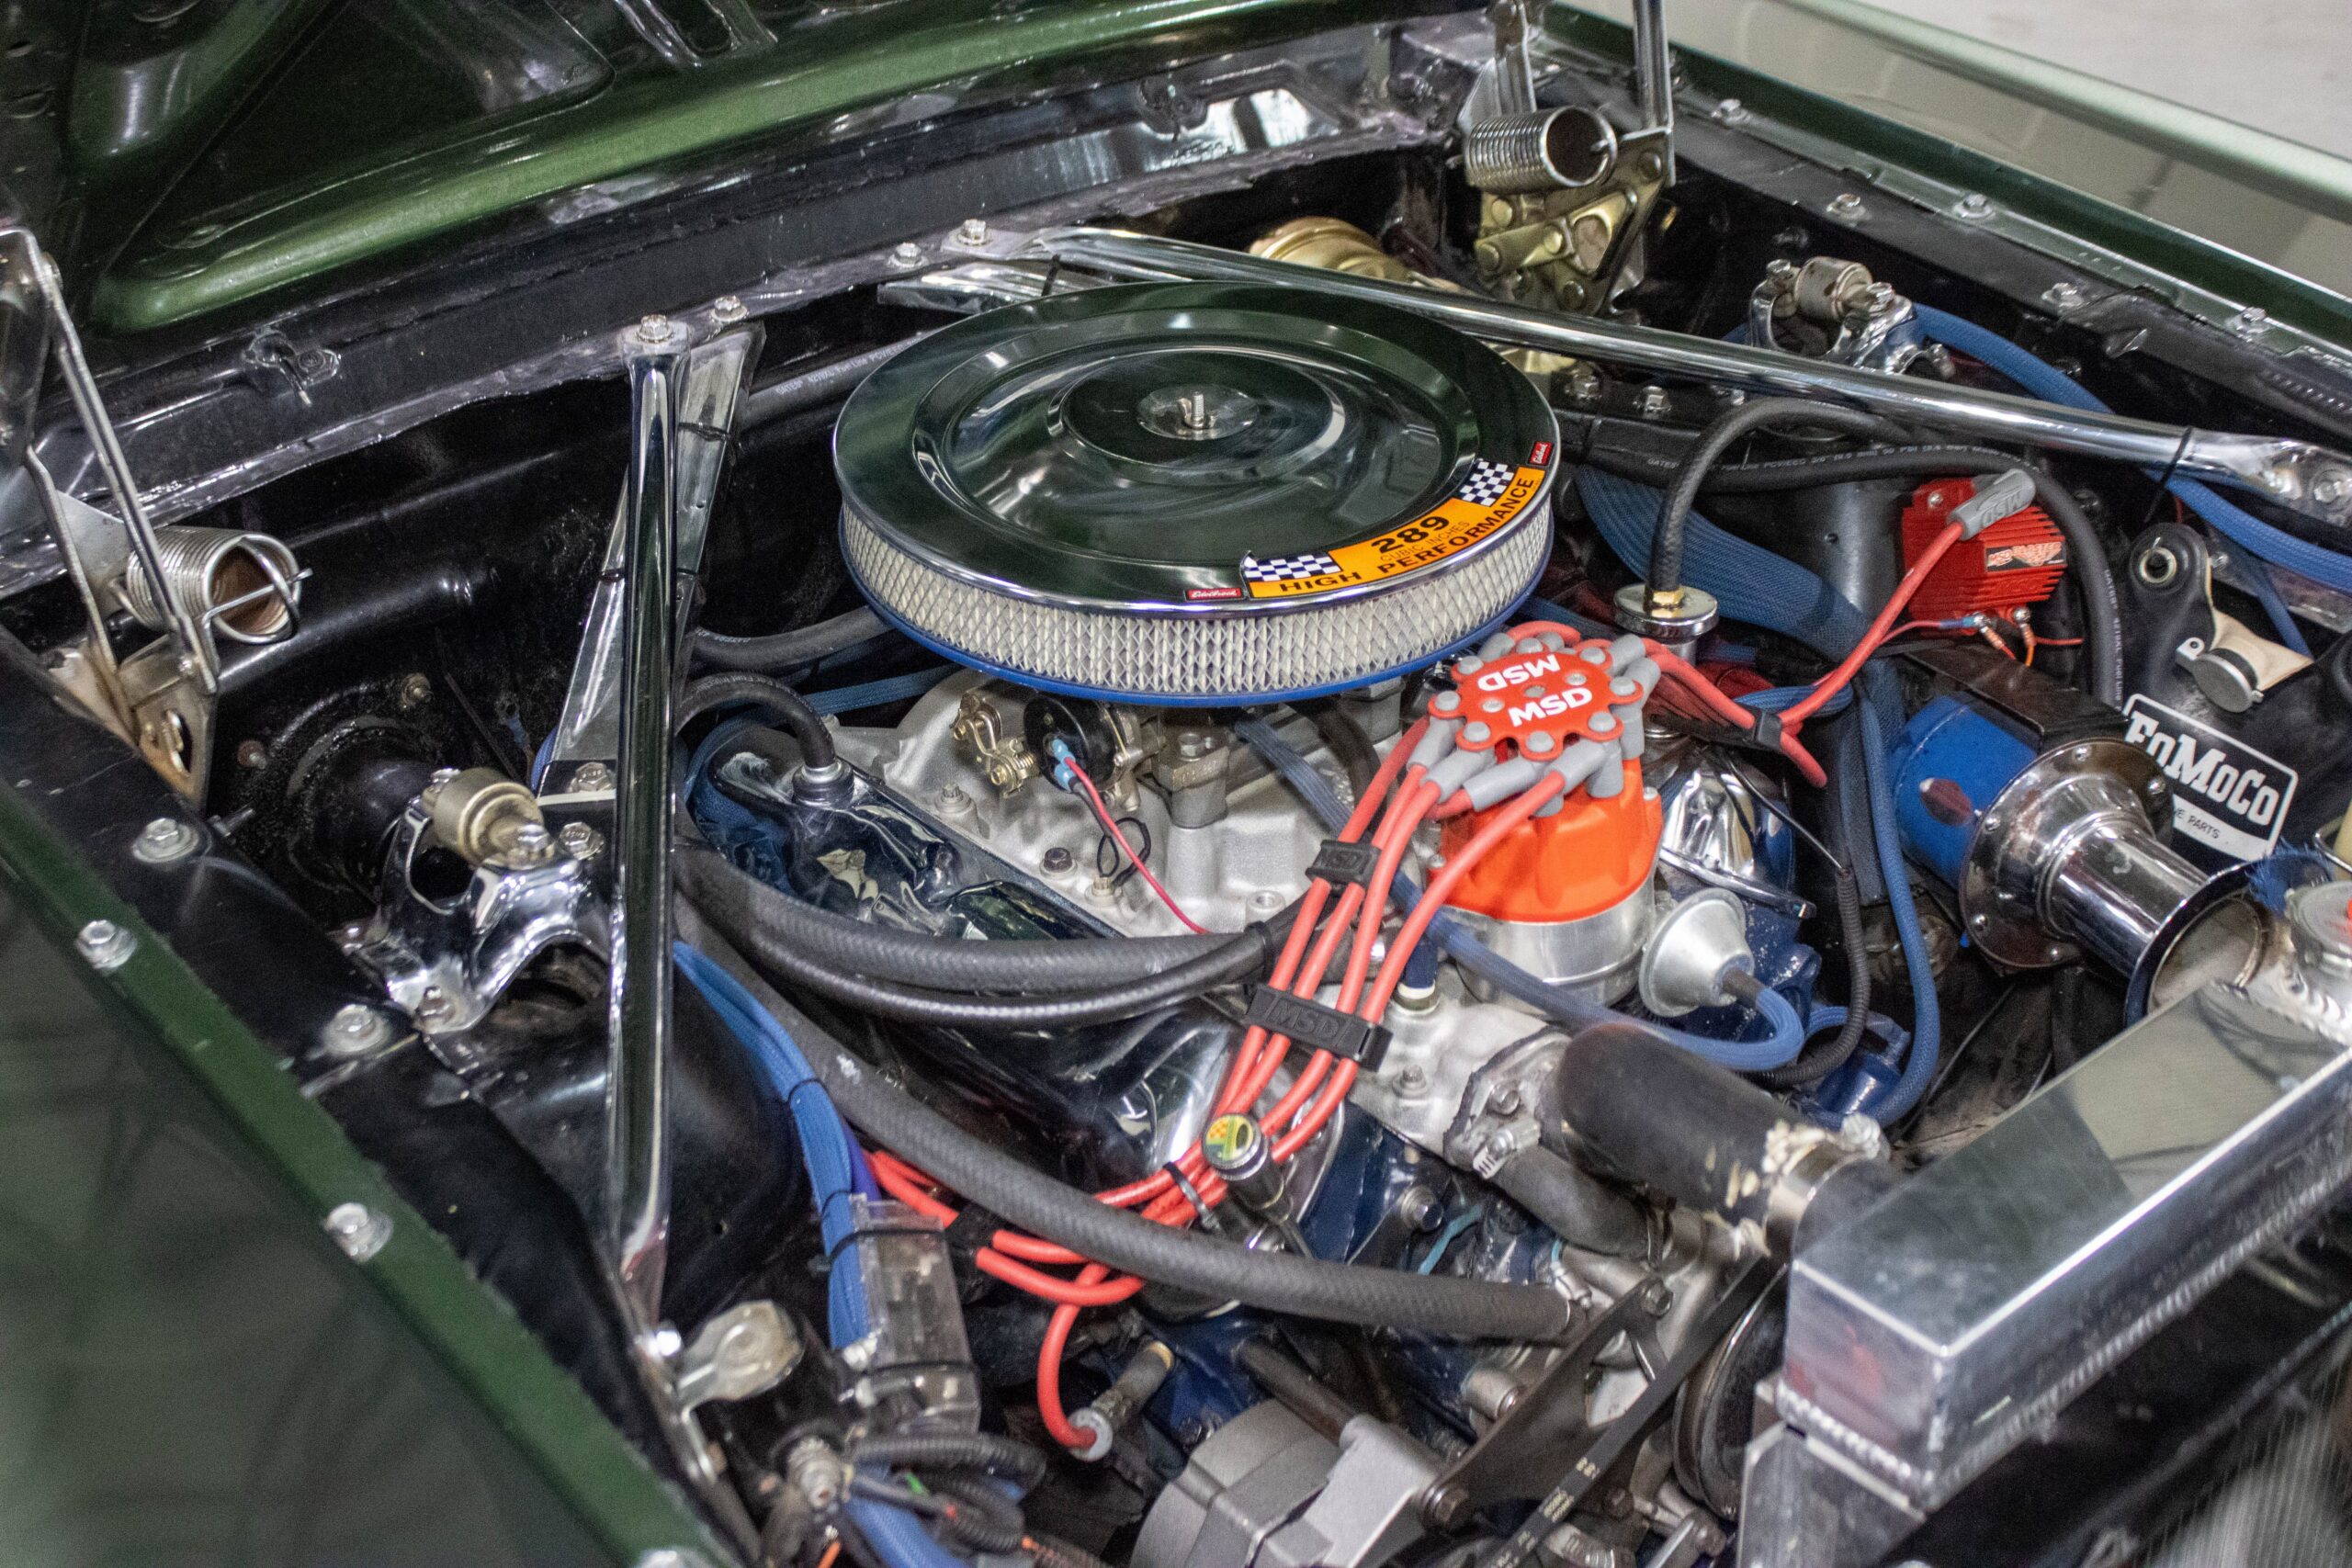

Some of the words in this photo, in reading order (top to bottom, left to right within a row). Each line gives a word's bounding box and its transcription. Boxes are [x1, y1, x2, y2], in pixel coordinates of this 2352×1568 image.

[1279, 570, 1362, 592] HIGH
[1377, 478, 1534, 574] PERFORMANCE
[1372, 515, 1450, 554] 289
[1380, 545, 1424, 562] CUBIC
[1426, 521, 1471, 547] INCHES
[1477, 654, 1561, 691] MSD
[1508, 687, 1592, 727] MSD
[2125, 711, 2279, 826] FoMoCo
[2188, 815, 2222, 840] PARTS
[1272, 1002, 1341, 1040] MSD
